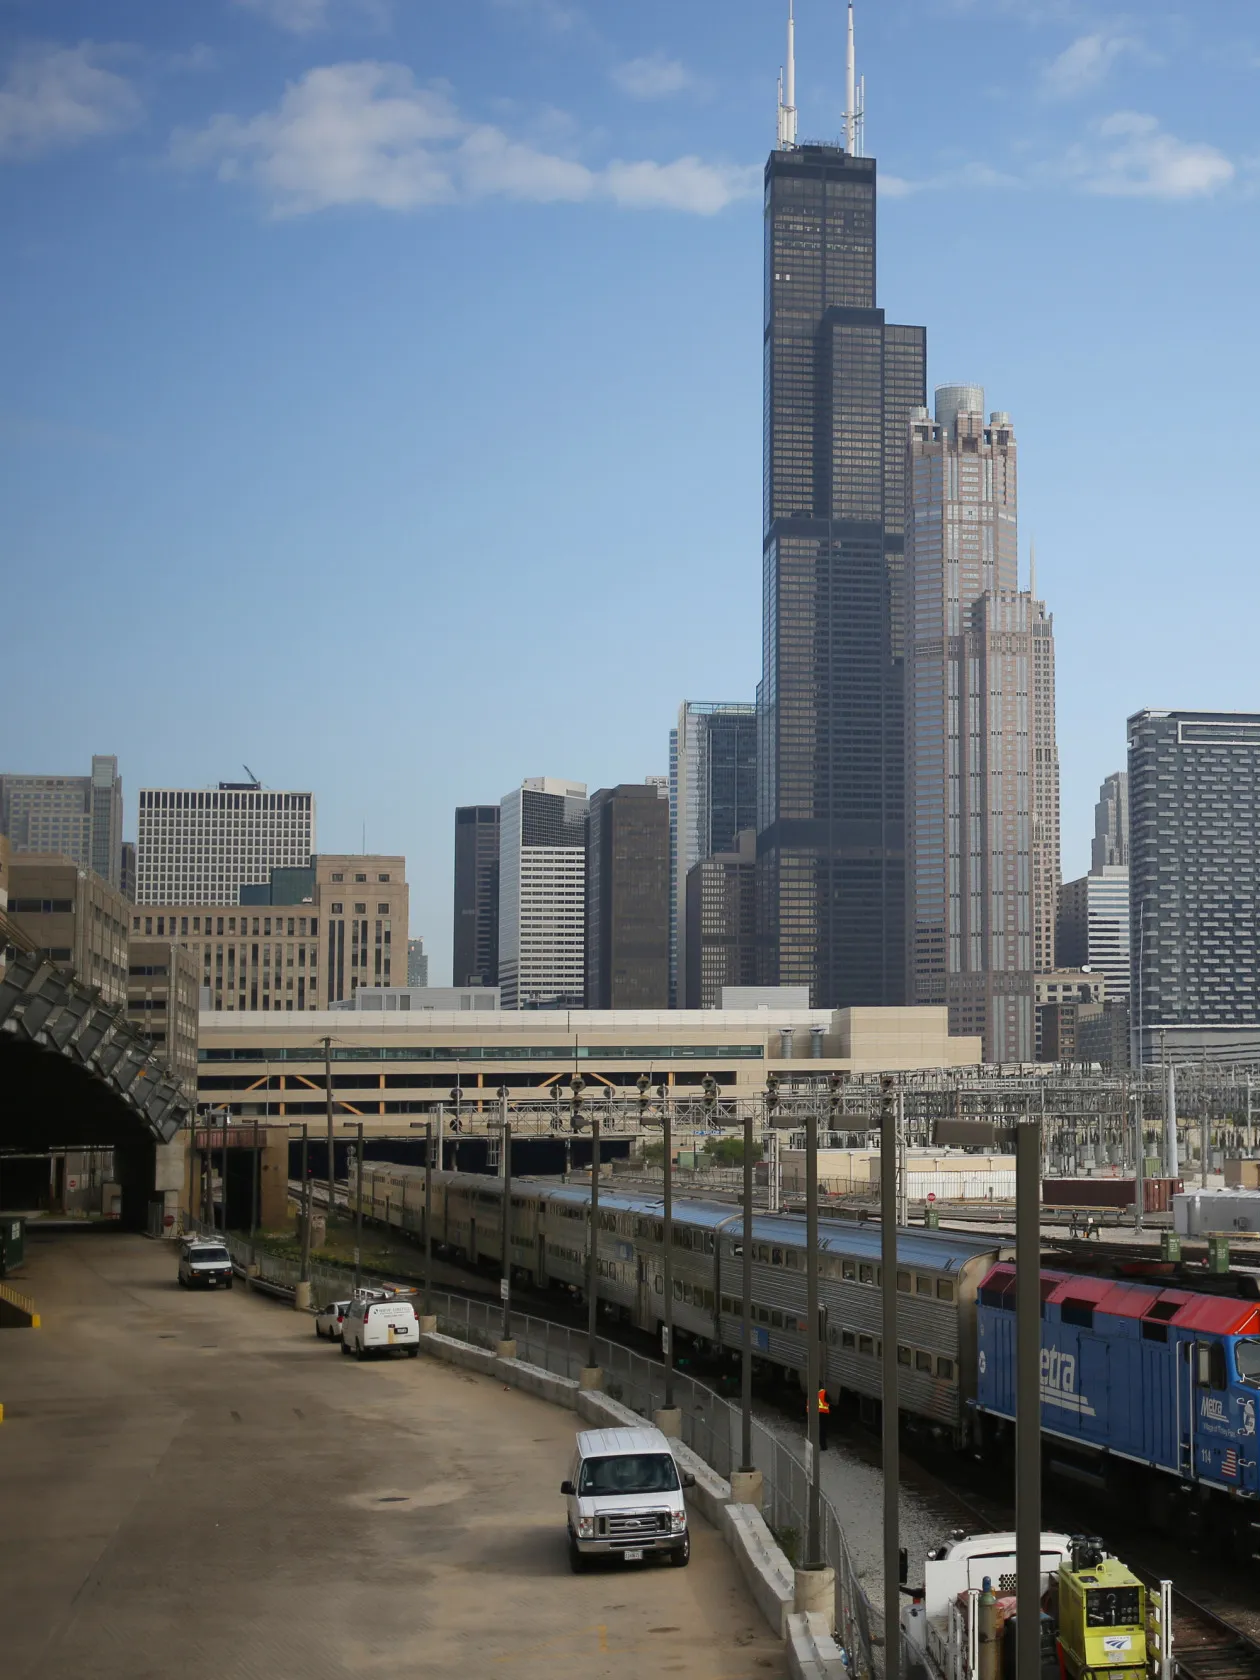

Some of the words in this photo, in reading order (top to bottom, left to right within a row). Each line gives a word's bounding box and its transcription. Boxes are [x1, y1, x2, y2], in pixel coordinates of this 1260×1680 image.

[1040, 1344, 1075, 1393] etra
[1200, 1396, 1223, 1417] Metra
[1201, 1449, 1212, 1465] 114
